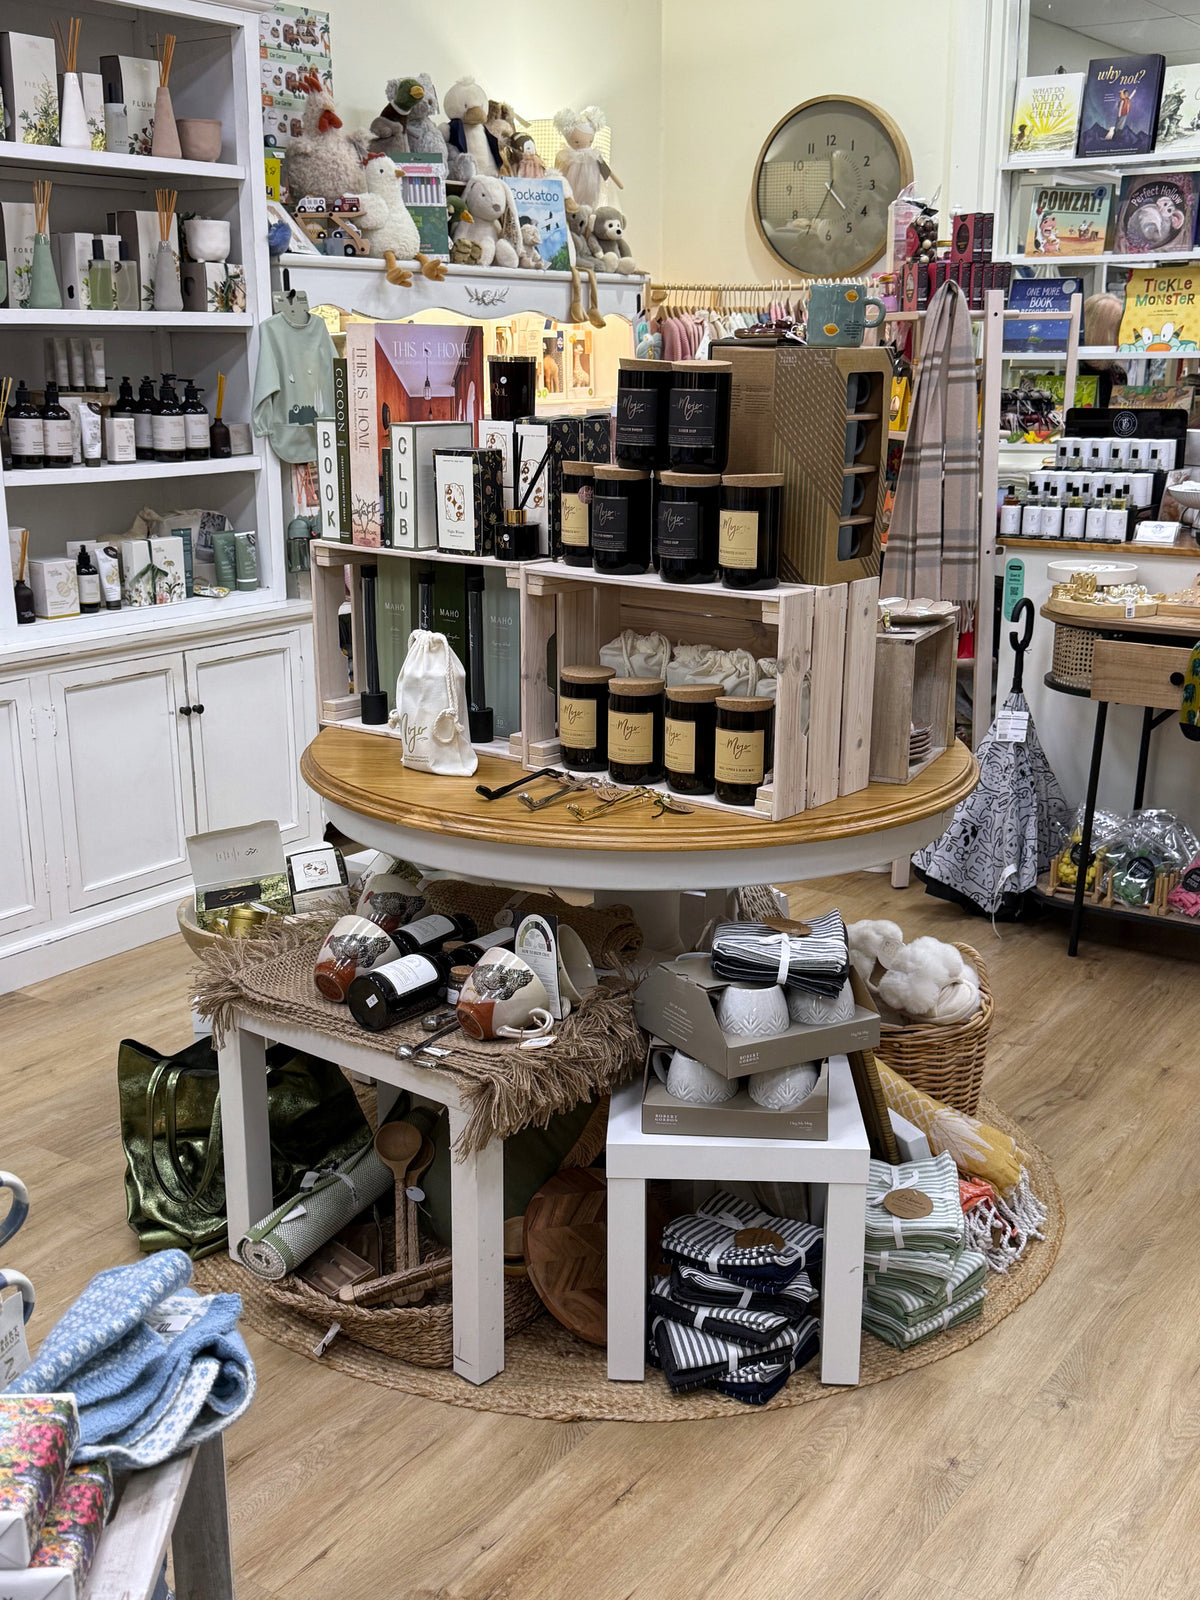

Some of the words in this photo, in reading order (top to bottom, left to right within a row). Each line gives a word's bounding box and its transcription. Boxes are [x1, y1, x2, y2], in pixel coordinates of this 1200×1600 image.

[1097, 65, 1121, 84] why
[1120, 69, 1146, 85] not?
[1032, 87, 1053, 95] WHAT
[1055, 86, 1066, 94] DO
[1032, 94, 1050, 103] YOU
[1051, 93, 1065, 101] DO
[1031, 101, 1055, 111] WITH
[1055, 101, 1064, 110] A
[1029, 109, 1067, 119] CHANCE?
[826, 134, 837, 146] 12
[851, 140, 855, 151] 1
[808, 143, 815, 154] 11
[793, 160, 805, 172] 10
[863, 155, 871, 167] 2
[786, 185, 793, 196] 9
[869, 179, 876, 191] 3
[1038, 190, 1104, 213] COWZAT!
[1131, 185, 1160, 207] Perfect
[1160, 184, 1184, 206] Hollow
[792, 209, 799, 220] 8
[860, 205, 868, 217] 4
[805, 224, 812, 236] 7
[846, 222, 853, 234] 5
[825, 230, 832, 241] 6
[1026, 287, 1041, 297] ONE
[1041, 286, 1061, 297] MORE
[1029, 297, 1054, 309] BOOK
[393, 340, 417, 358] THIS
[422, 340, 432, 359] IS
[437, 341, 471, 359] HOME
[355, 343, 368, 378] THIS
[357, 387, 369, 400] IS
[1038, 380, 1090, 394] BEATY
[335, 368, 346, 432] COCOON
[623, 395, 645, 420] Mojo
[678, 395, 703, 421] Mojo
[358, 408, 371, 455] HOME
[322, 430, 337, 529] BOOK
[397, 435, 409, 537] CLUB
[595, 502, 614, 526] Mojo
[663, 507, 684, 533] Mojo
[720, 517, 744, 542] Mojo
[563, 703, 583, 725] Mojo
[617, 718, 641, 741] Mojo
[726, 736, 752, 760] Mojo
